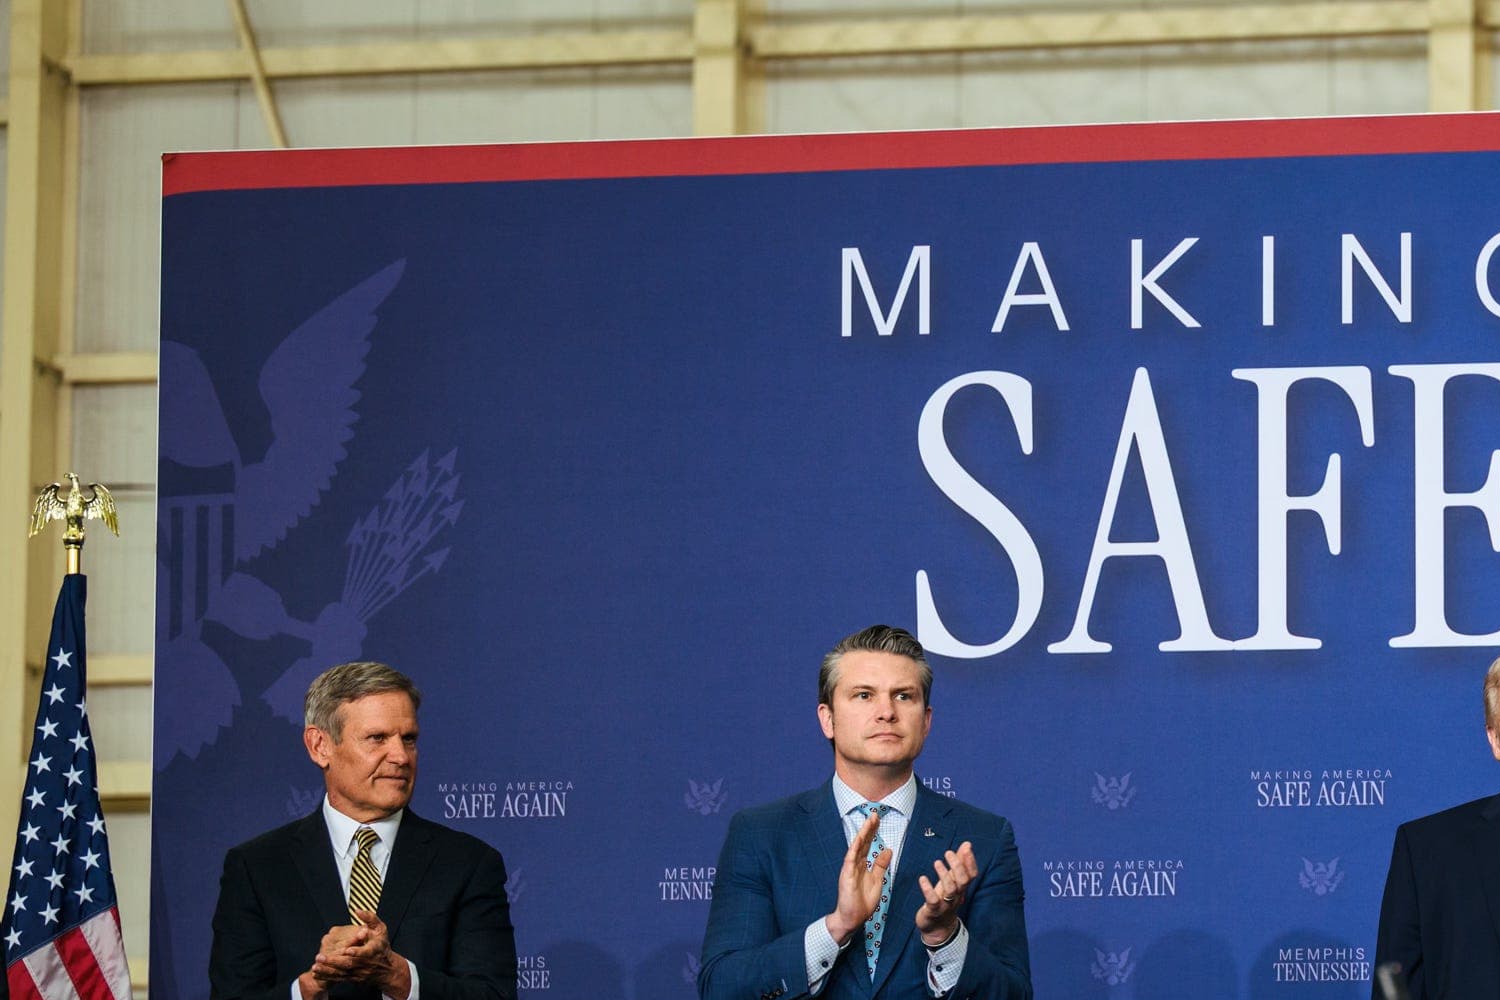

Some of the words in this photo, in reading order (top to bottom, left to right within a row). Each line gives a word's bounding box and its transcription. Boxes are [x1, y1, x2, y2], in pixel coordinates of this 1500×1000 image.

[1250, 770, 1312, 781] MAKING
[1321, 768, 1393, 779] AMERICA
[438, 782, 497, 793] MAKING
[506, 781, 574, 791] AMERICA
[1257, 781, 1311, 807] SAFE
[1315, 780, 1385, 806] AGAIN
[444, 793, 496, 819] SAFE
[500, 792, 567, 818] AGAIN
[664, 866, 717, 880] MEMP
[1043, 860, 1105, 871] MAKING
[1113, 859, 1184, 870] AMERICA
[658, 881, 714, 901] TENNE
[1050, 871, 1103, 898] SAFE
[1107, 870, 1177, 897] AGAIN
[1279, 947, 1365, 961] MEMPHIS
[1272, 961, 1370, 982] TENNESSEE
